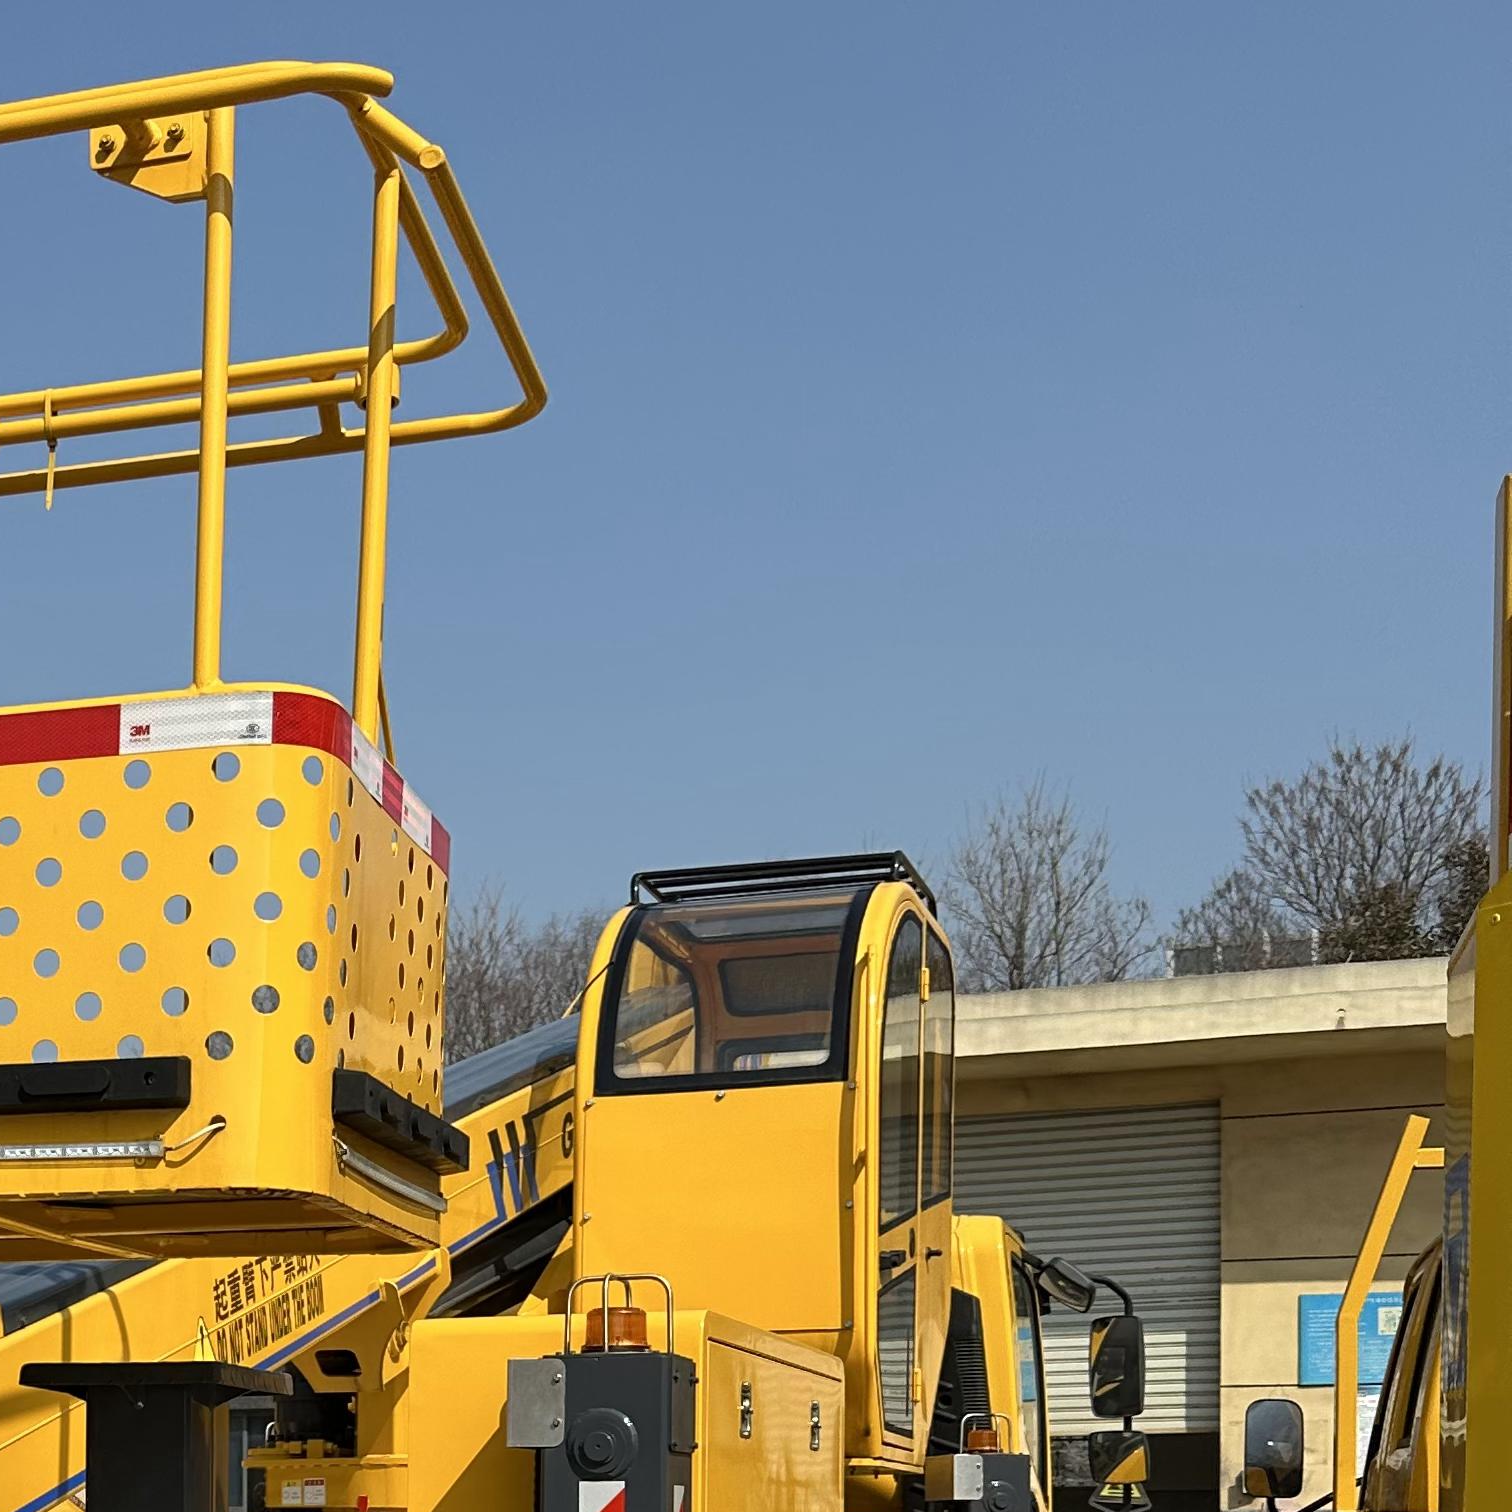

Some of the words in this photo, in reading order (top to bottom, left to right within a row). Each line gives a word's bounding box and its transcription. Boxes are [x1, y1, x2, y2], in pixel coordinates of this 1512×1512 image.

[130, 725, 150, 736] 3M
[229, 1318, 244, 1364] NOT
[245, 1305, 268, 1358] STAND
[268, 1292, 292, 1344] UNDER
[291, 1284, 306, 1329] THE
